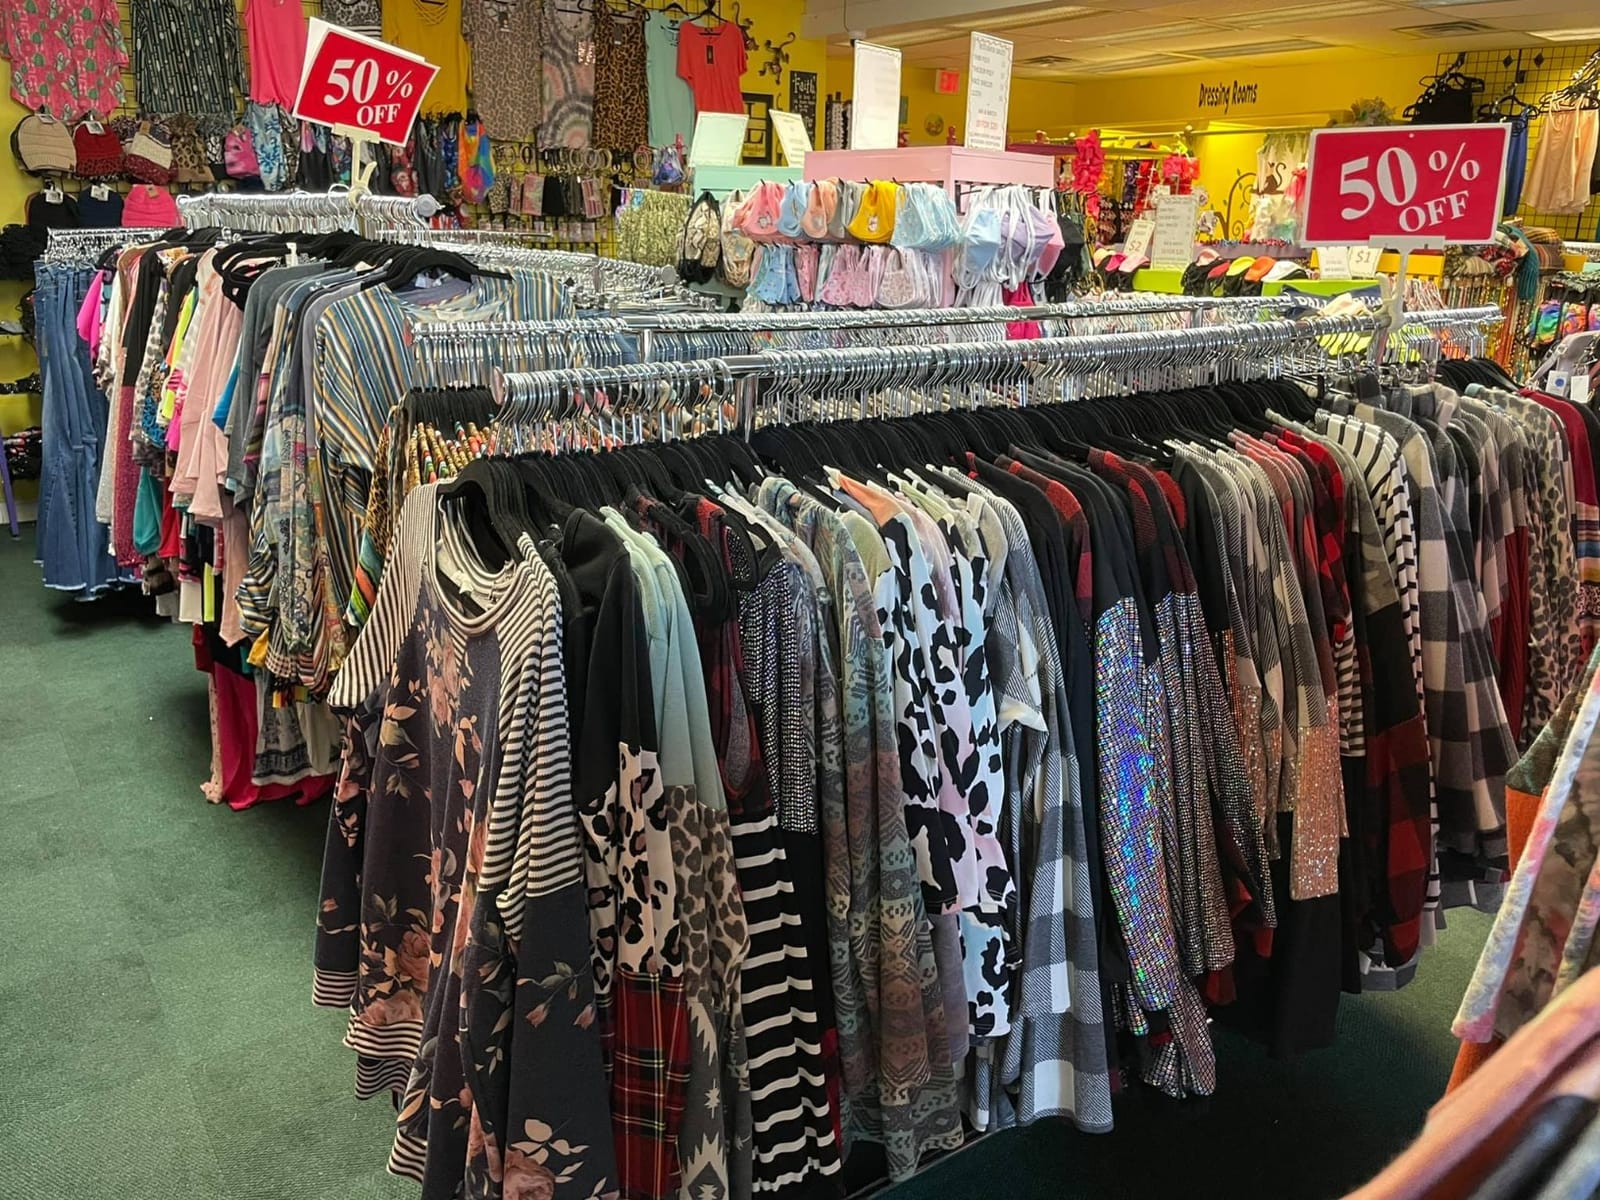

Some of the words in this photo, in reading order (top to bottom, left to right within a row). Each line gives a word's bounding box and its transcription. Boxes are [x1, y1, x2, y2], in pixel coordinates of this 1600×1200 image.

[1198, 82, 1230, 115] Dressing
[1232, 80, 1258, 105] Rooms
[356, 103, 401, 127] OFF
[1398, 190, 1470, 233] OFF
[1356, 249, 1371, 264] $1
